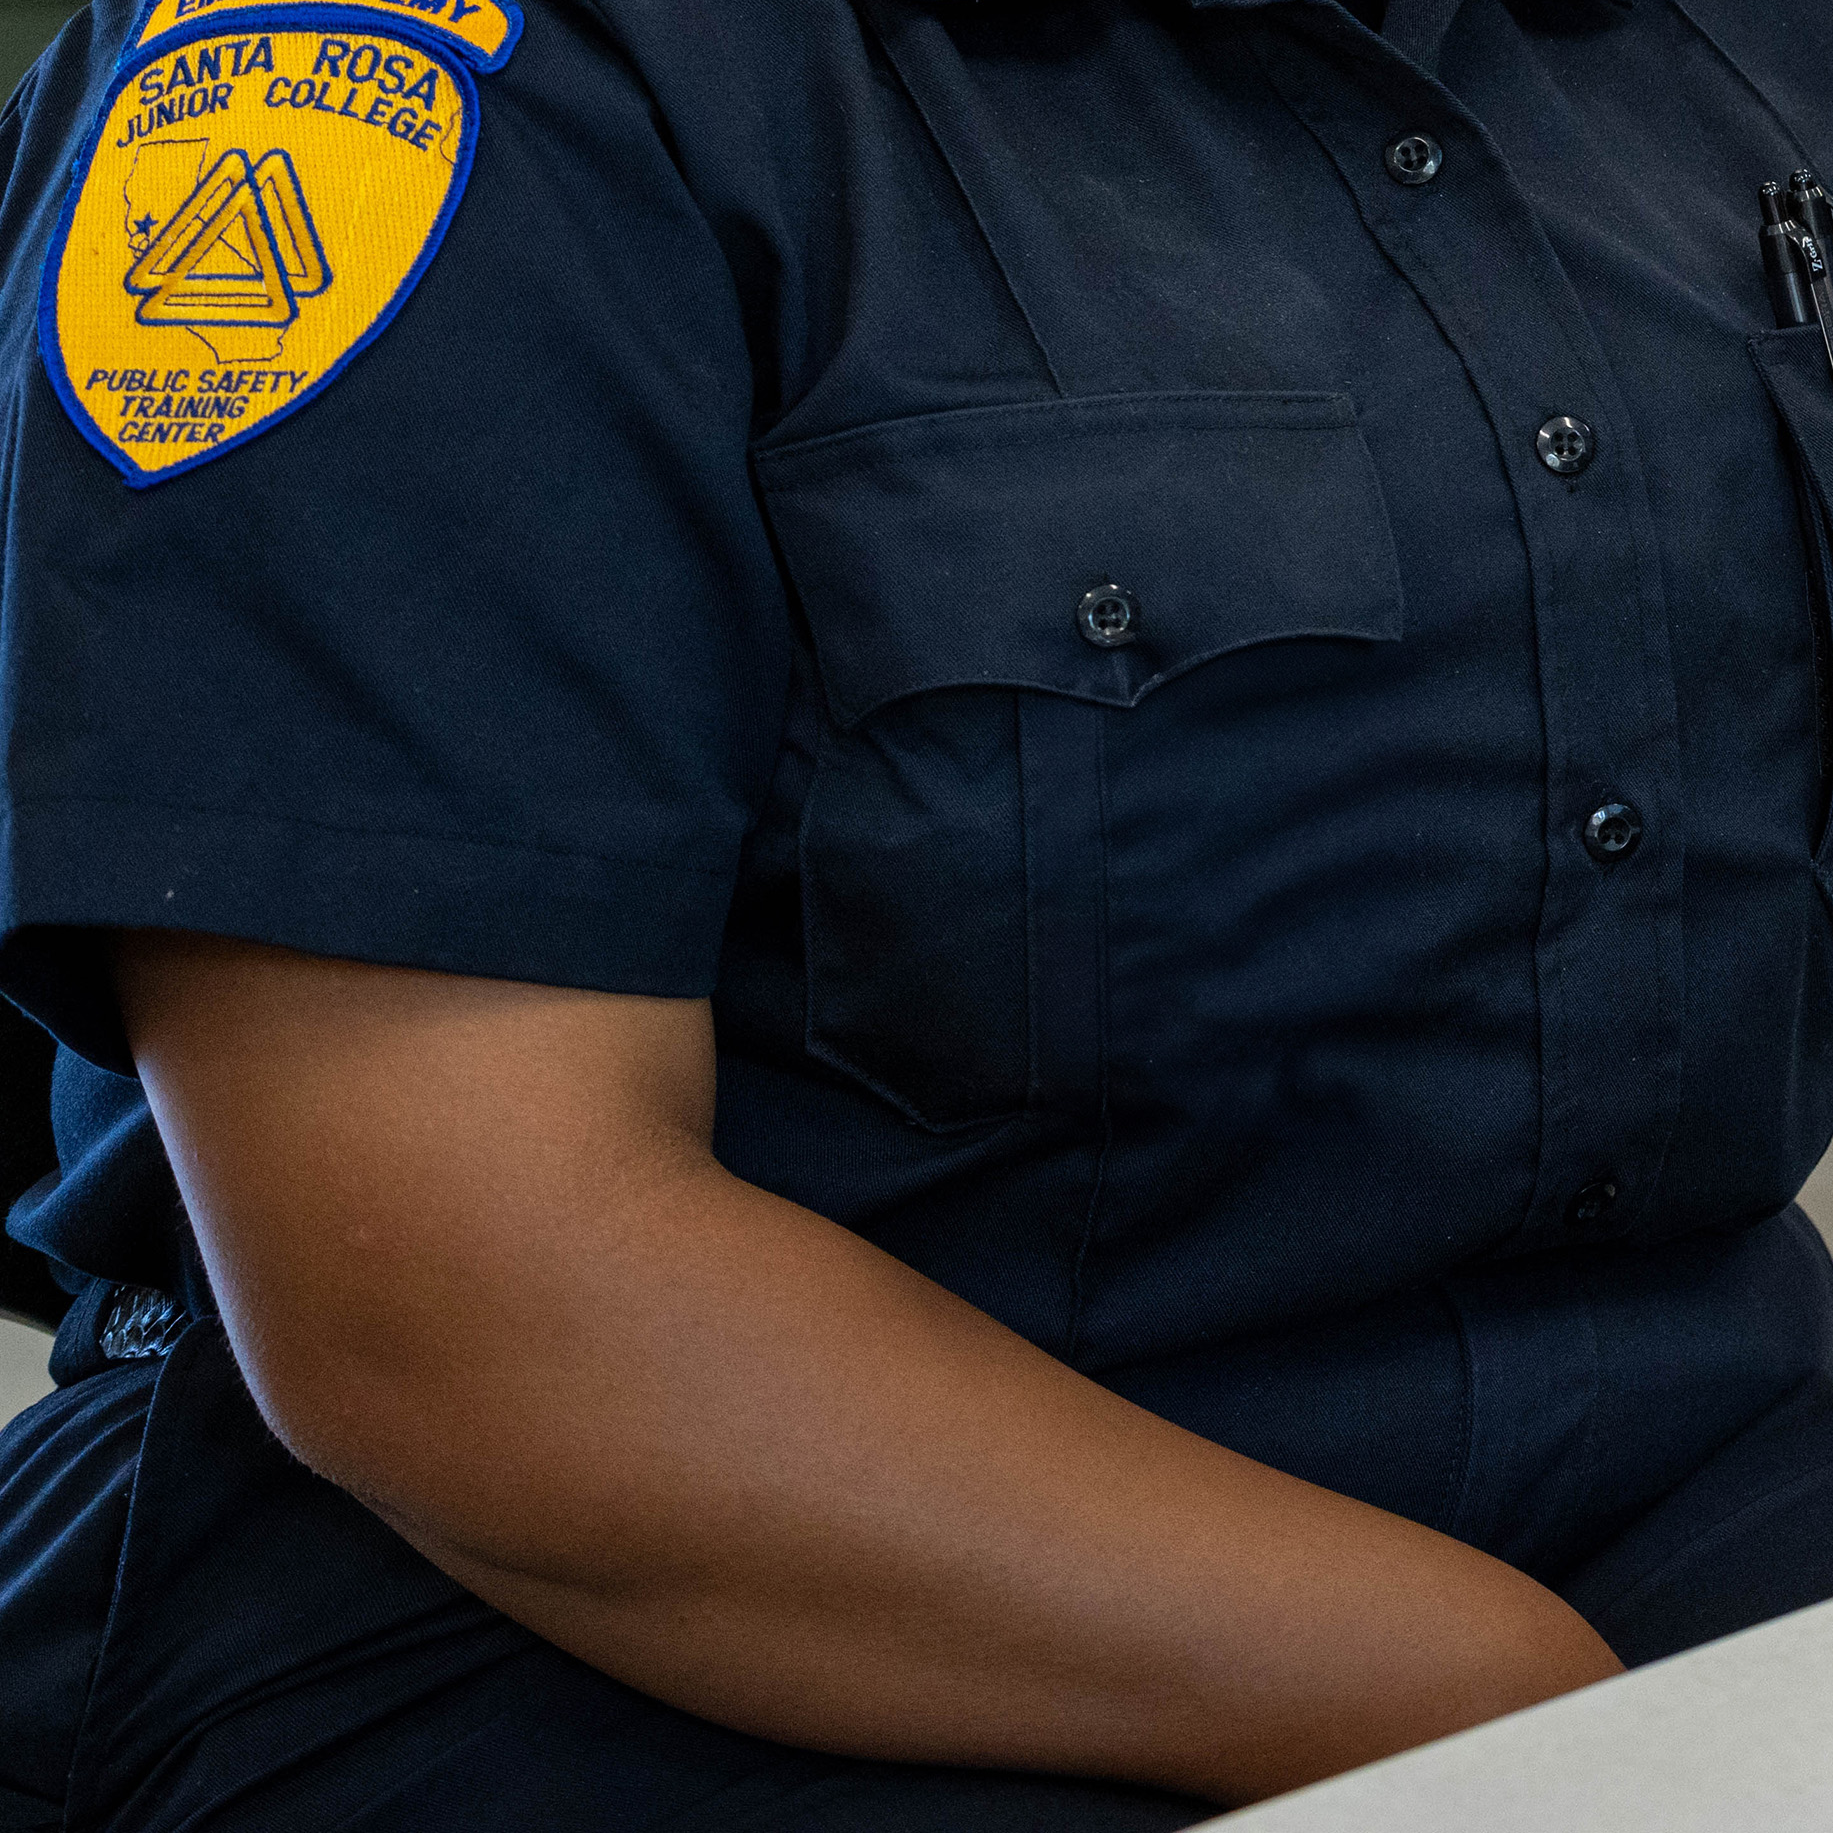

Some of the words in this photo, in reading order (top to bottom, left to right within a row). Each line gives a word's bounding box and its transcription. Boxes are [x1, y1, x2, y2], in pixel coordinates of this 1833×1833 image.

[138, 36, 274, 106] SANTA
[314, 38, 441, 110] ROSA
[116, 82, 234, 149] JUNIOR
[264, 77, 443, 151] COLLEGE
[86, 370, 190, 394] PUBLIC
[197, 370, 309, 395] SAFETY
[118, 395, 246, 420] TRAINING
[117, 420, 226, 444] CENTER
